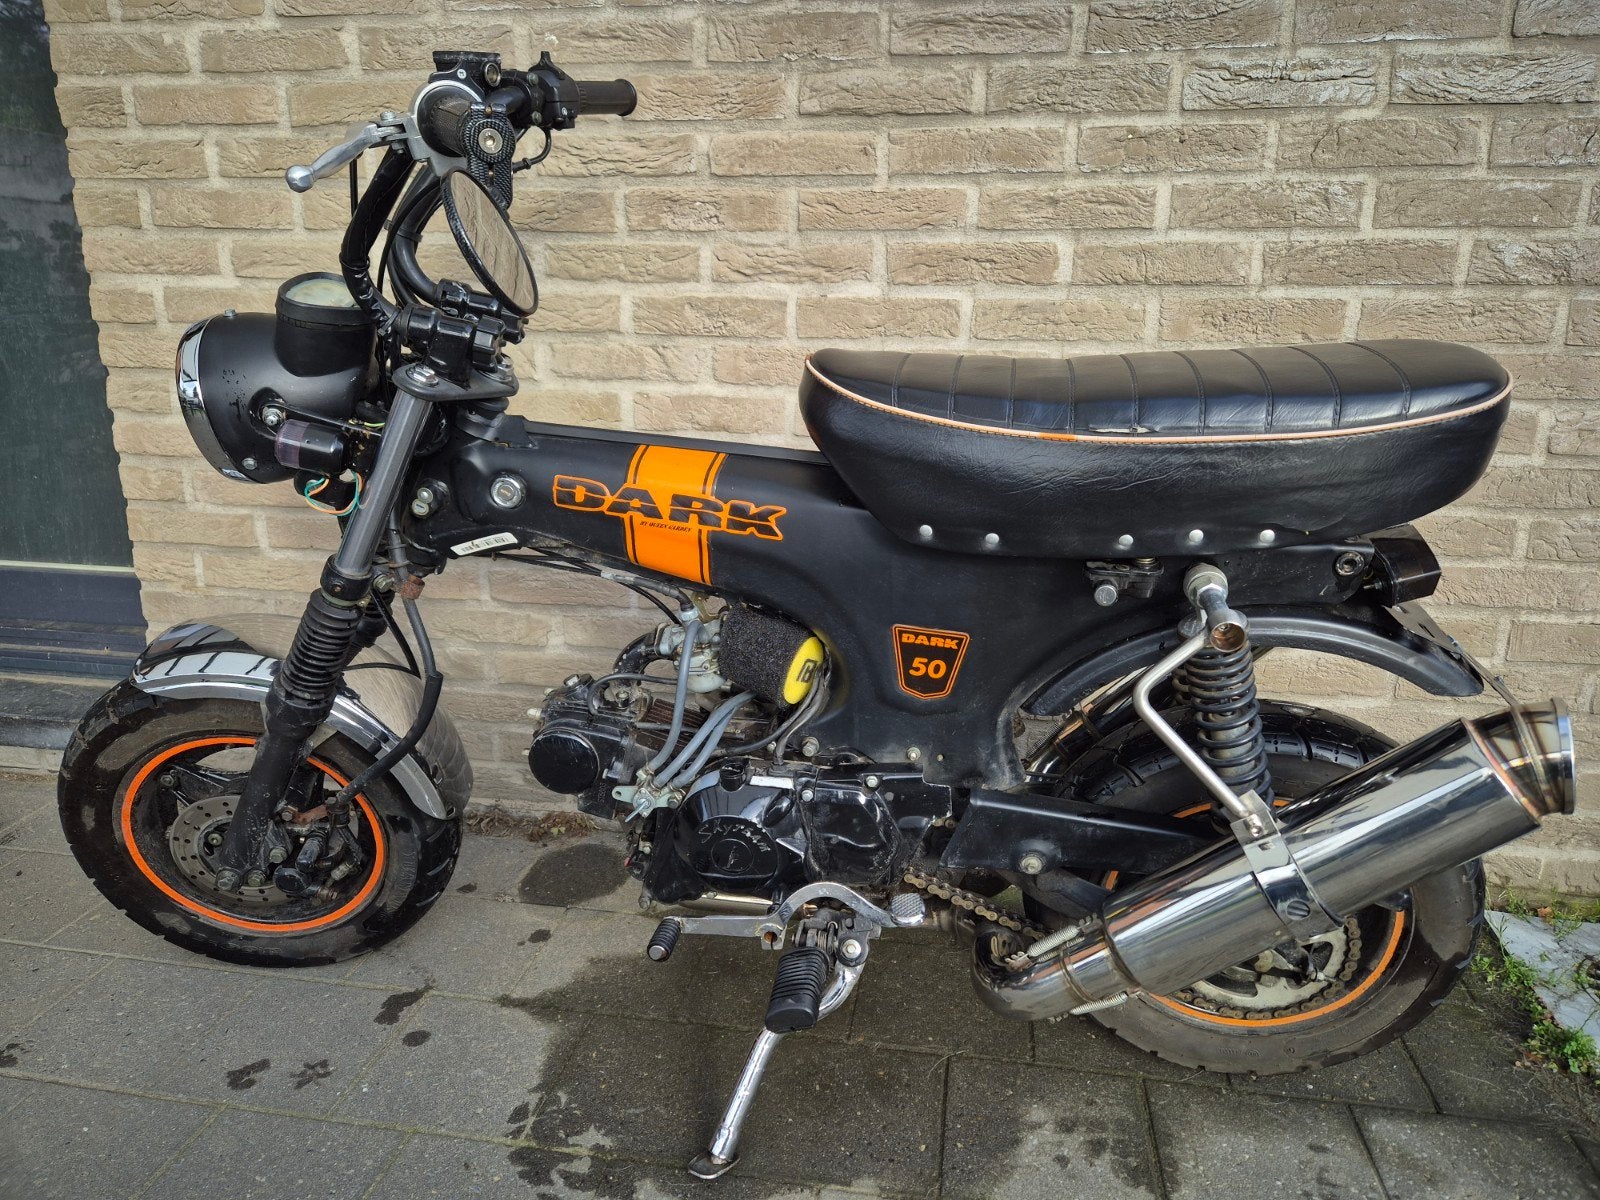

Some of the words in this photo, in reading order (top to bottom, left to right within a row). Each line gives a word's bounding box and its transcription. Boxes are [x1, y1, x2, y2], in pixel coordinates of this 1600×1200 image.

[553, 475, 787, 541] DARK
[901, 633, 959, 650] DARK
[908, 657, 947, 679] 50
